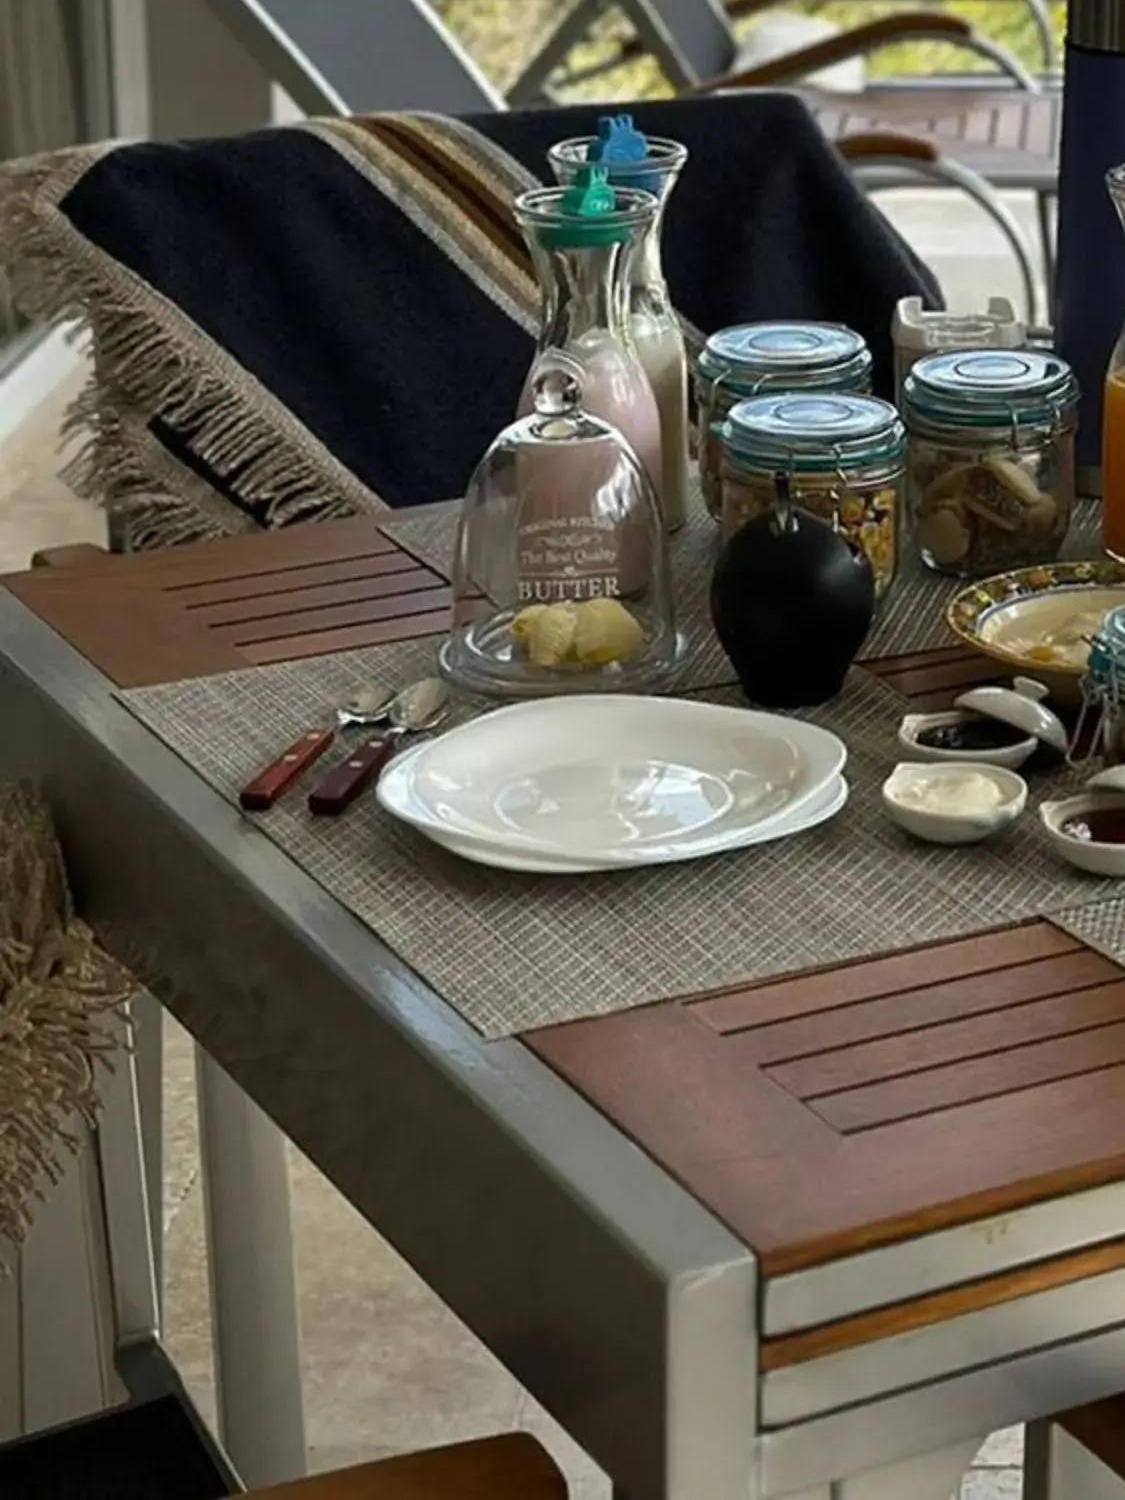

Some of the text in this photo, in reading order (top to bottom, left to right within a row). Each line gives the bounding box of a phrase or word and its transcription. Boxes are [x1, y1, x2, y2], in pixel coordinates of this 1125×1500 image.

[520, 548, 617, 565] The Best Quality
[518, 576, 621, 600] BUTTER
